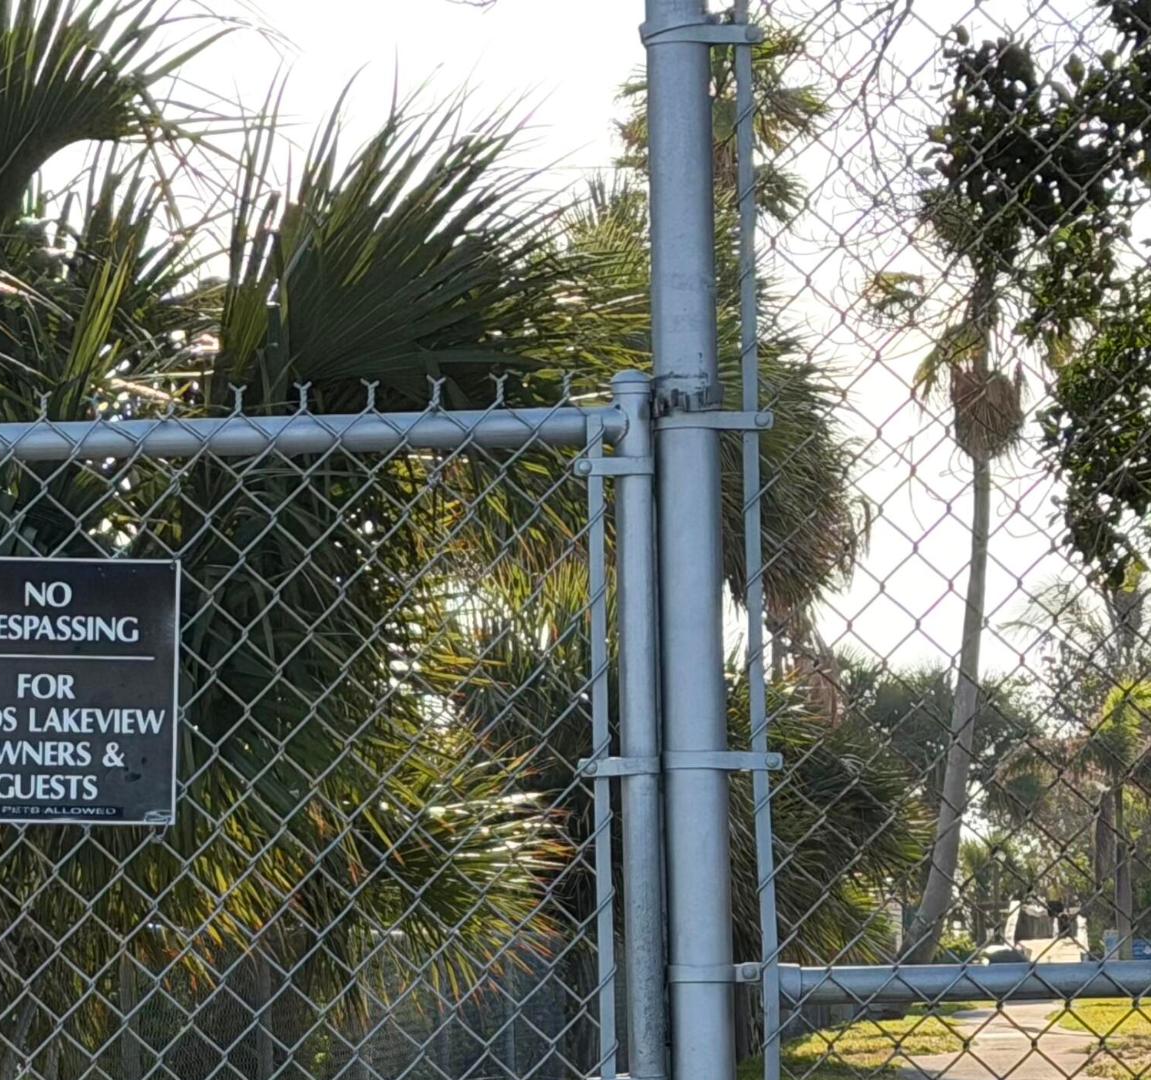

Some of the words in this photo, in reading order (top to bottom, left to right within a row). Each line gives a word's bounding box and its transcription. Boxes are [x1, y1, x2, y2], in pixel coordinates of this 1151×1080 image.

[24, 581, 72, 608] NO
[17, 673, 76, 700] FOR
[28, 707, 166, 734] LAKEVIEW
[102, 741, 125, 768] &
[1, 805, 40, 814] PETS
[44, 807, 117, 815] ALLOWED
